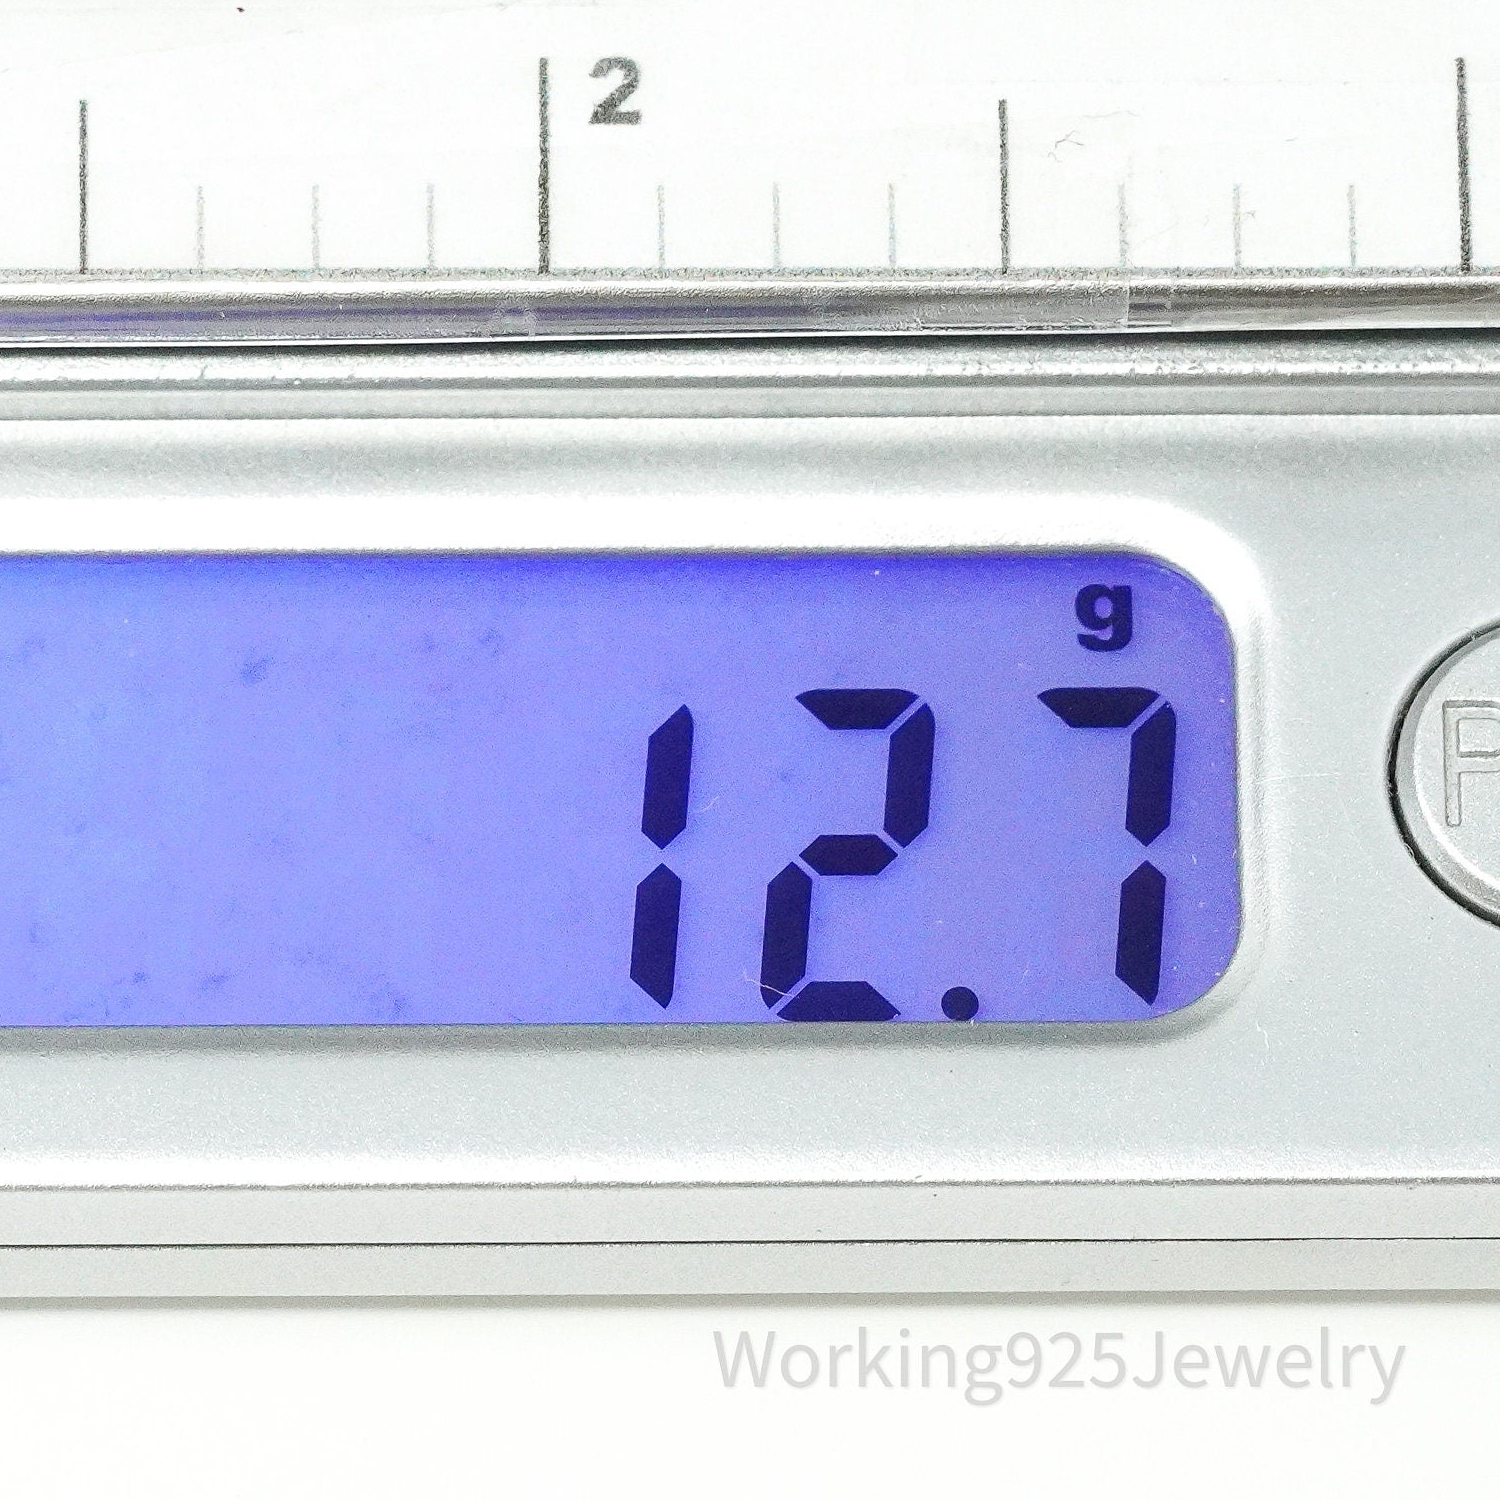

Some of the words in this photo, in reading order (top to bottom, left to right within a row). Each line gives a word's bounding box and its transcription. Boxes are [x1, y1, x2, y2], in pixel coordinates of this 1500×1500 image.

[588, 56, 643, 126] 2
[1074, 583, 1134, 653] g
[629, 687, 1177, 1023] 12.7
